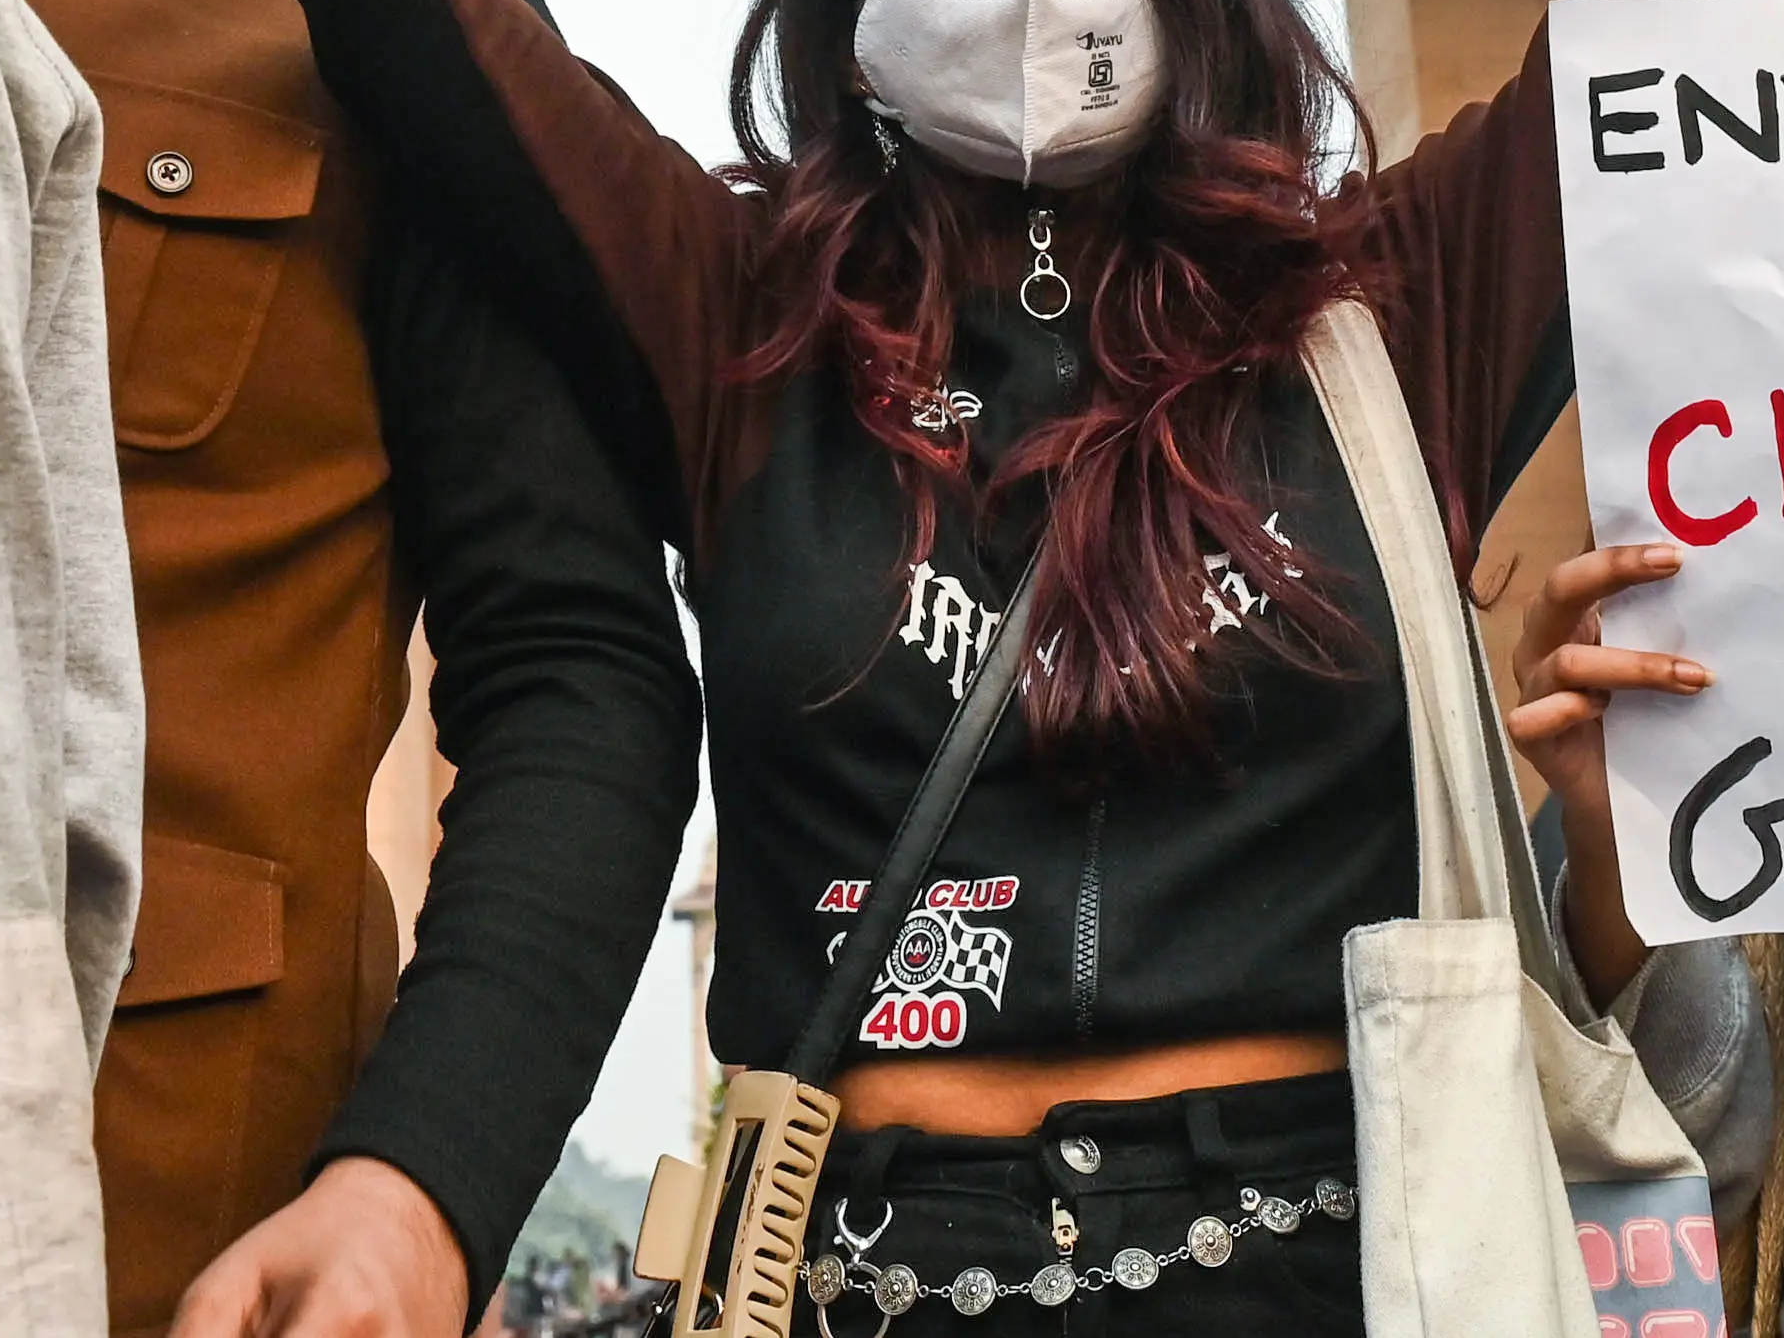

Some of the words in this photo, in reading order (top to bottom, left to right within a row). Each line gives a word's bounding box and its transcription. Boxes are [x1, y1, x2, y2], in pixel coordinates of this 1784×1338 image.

[927, 878, 1019, 910] CLUB
[905, 940, 931, 956] AAA
[862, 993, 965, 1047] 400
